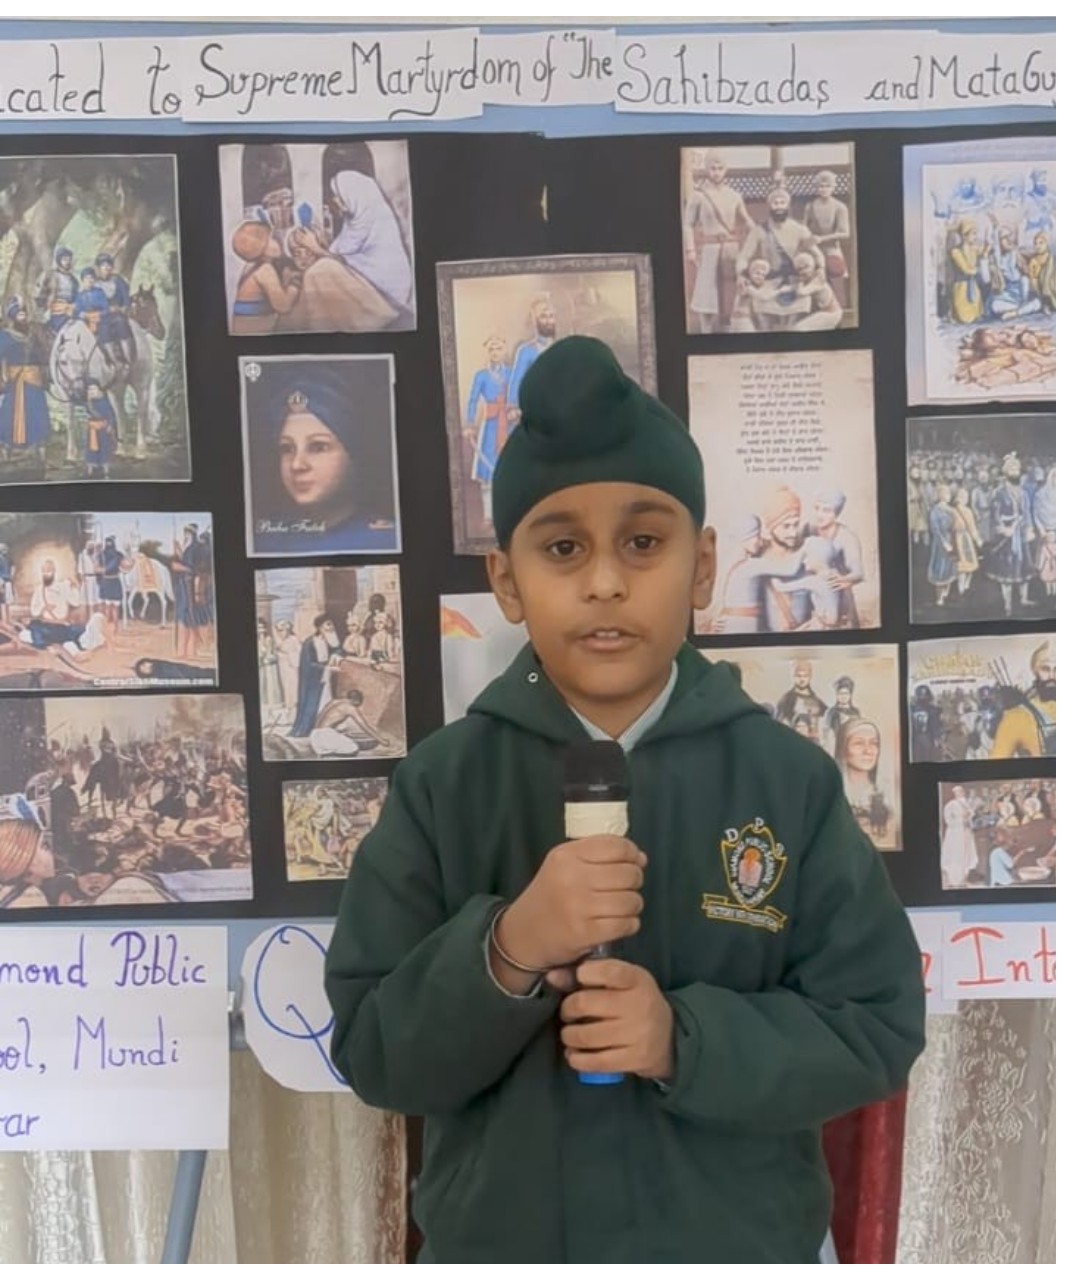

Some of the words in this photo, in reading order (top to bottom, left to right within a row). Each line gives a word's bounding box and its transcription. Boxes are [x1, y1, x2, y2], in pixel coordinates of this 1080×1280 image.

[0, 42, 105, 114] cated
[148, 46, 182, 115] to
[195, 42, 342, 115] Supreme
[532, 35, 555, 102] of
[616, 41, 829, 109] Sahibzadas
[865, 55, 920, 100] and
[110, 930, 208, 989] Public
[73, 1015, 180, 1072] Mundi
